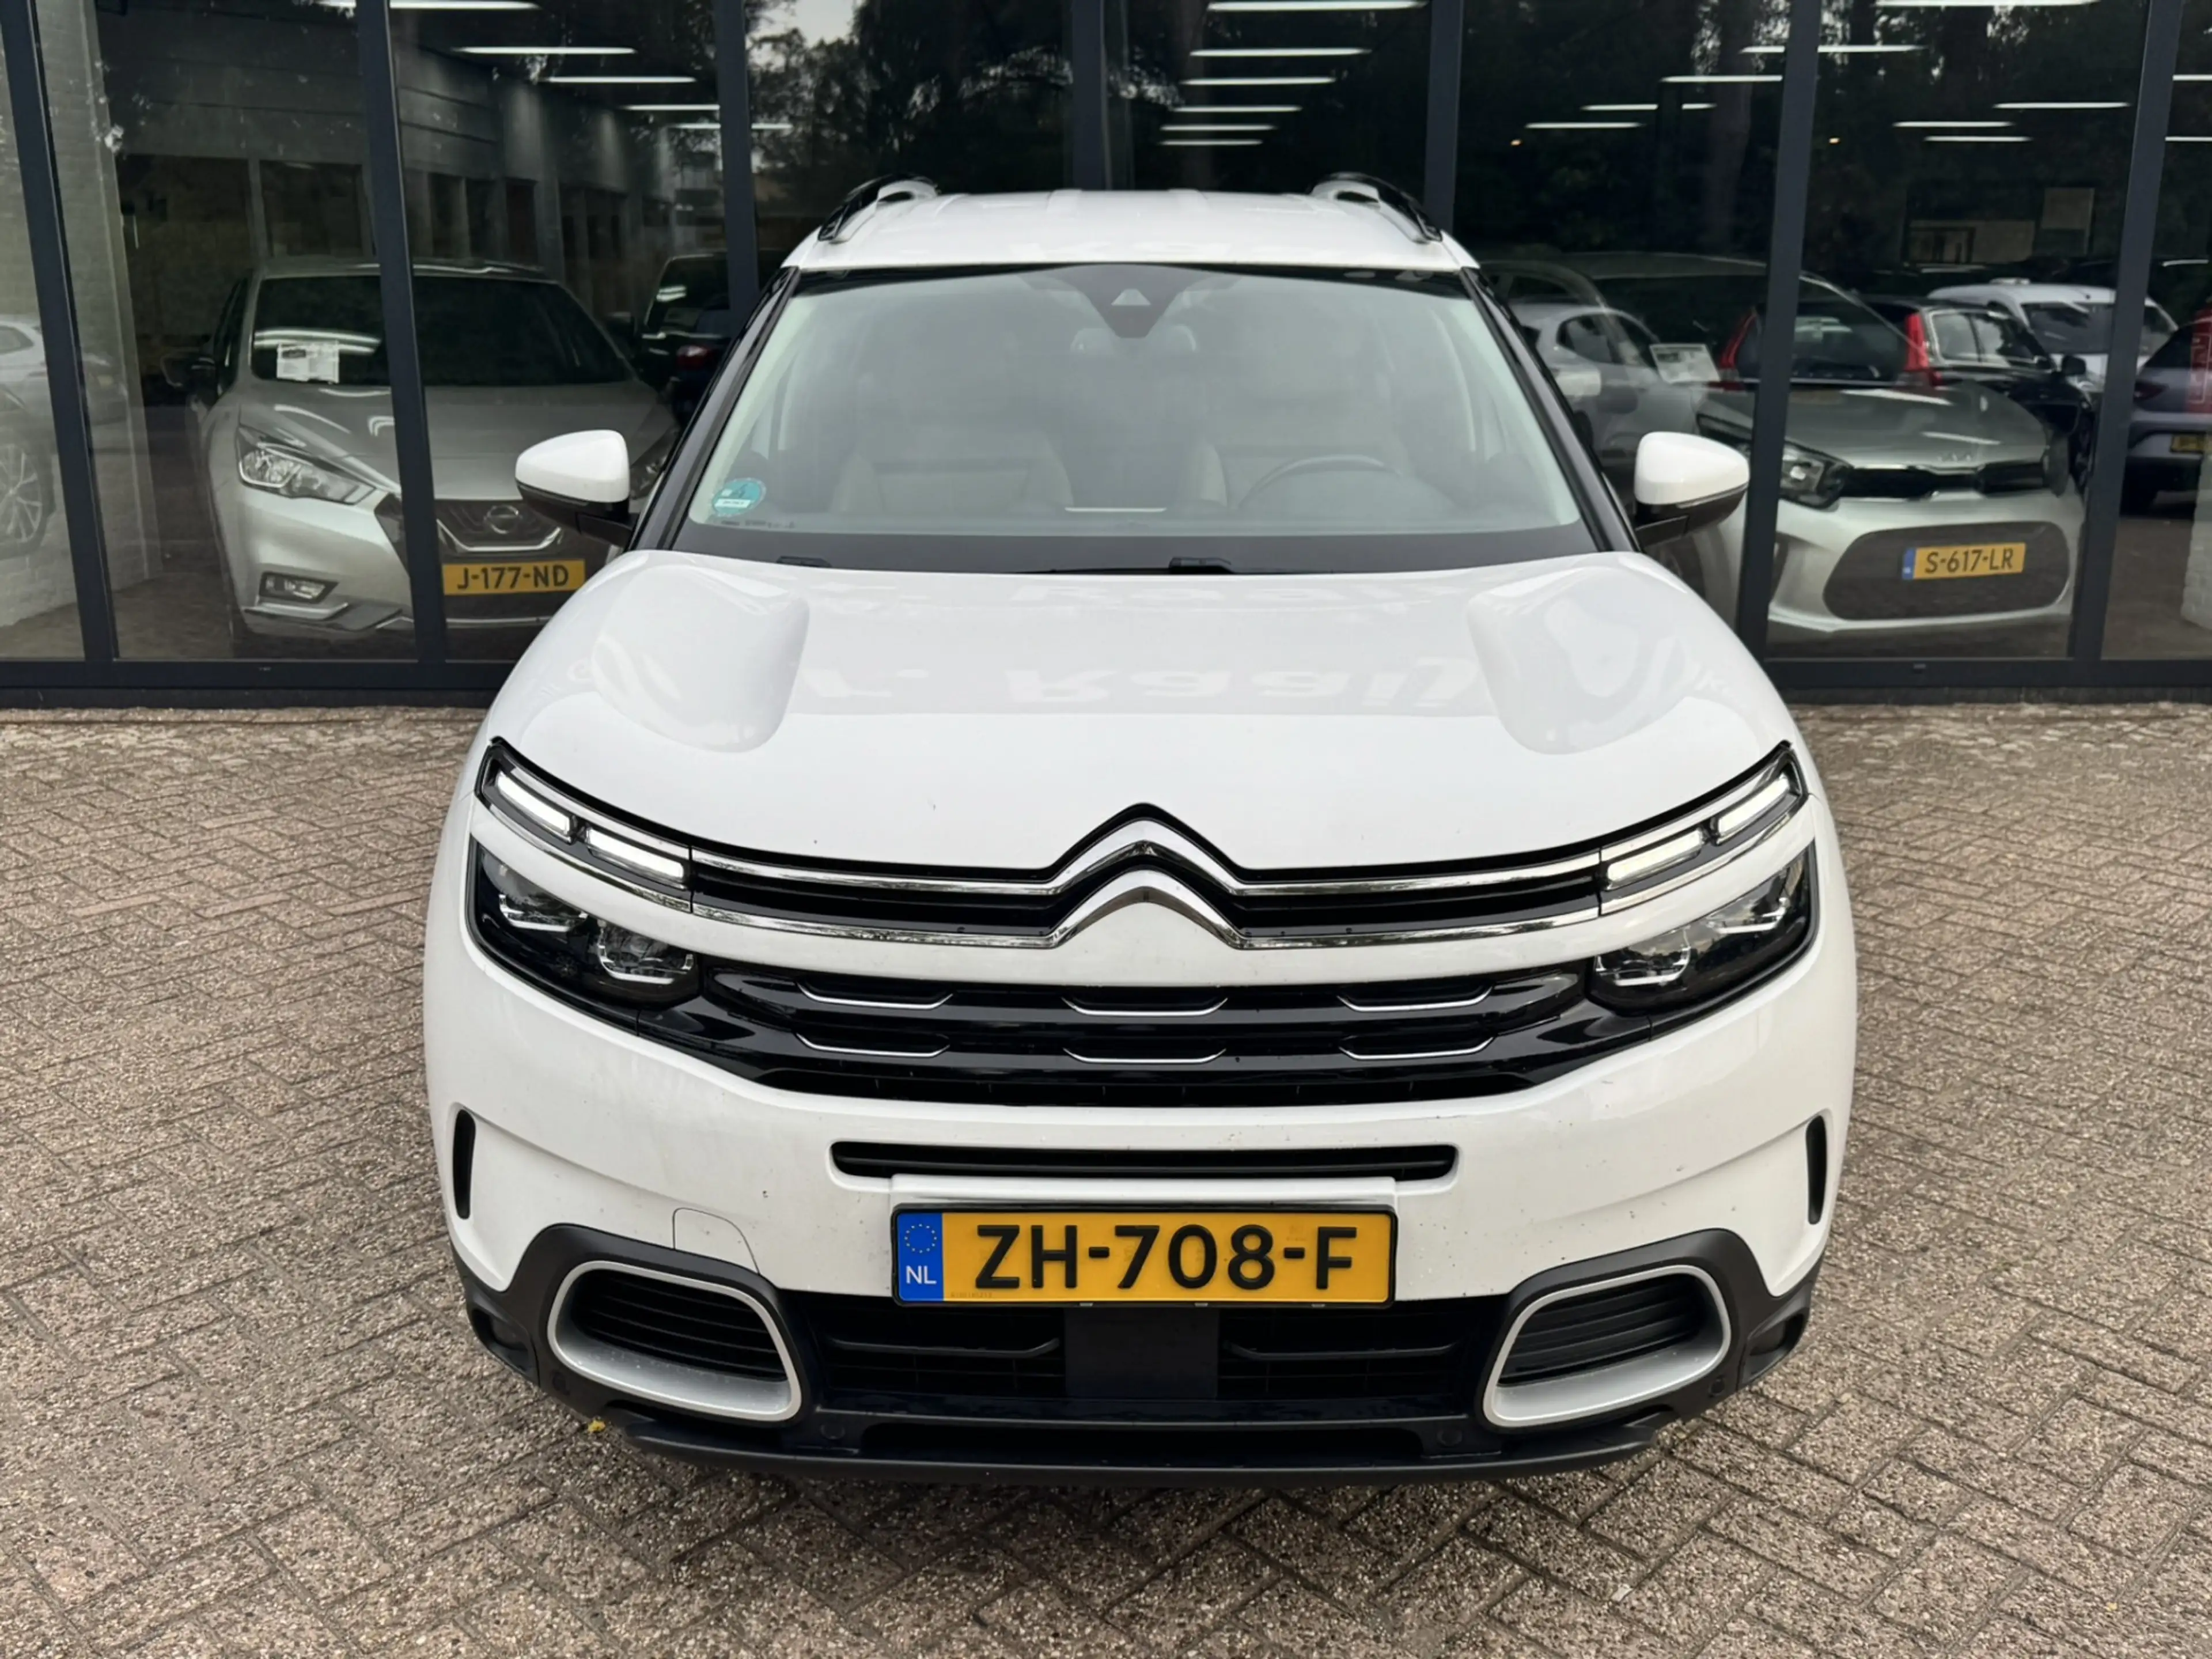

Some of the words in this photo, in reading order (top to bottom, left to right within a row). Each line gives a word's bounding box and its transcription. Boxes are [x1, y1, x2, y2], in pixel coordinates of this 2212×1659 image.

[1925, 547, 2013, 574] S-617-LR
[457, 565, 569, 590] J-177-ND
[906, 1266, 937, 1285] NL
[975, 1224, 1357, 1290] ZH-708-F
